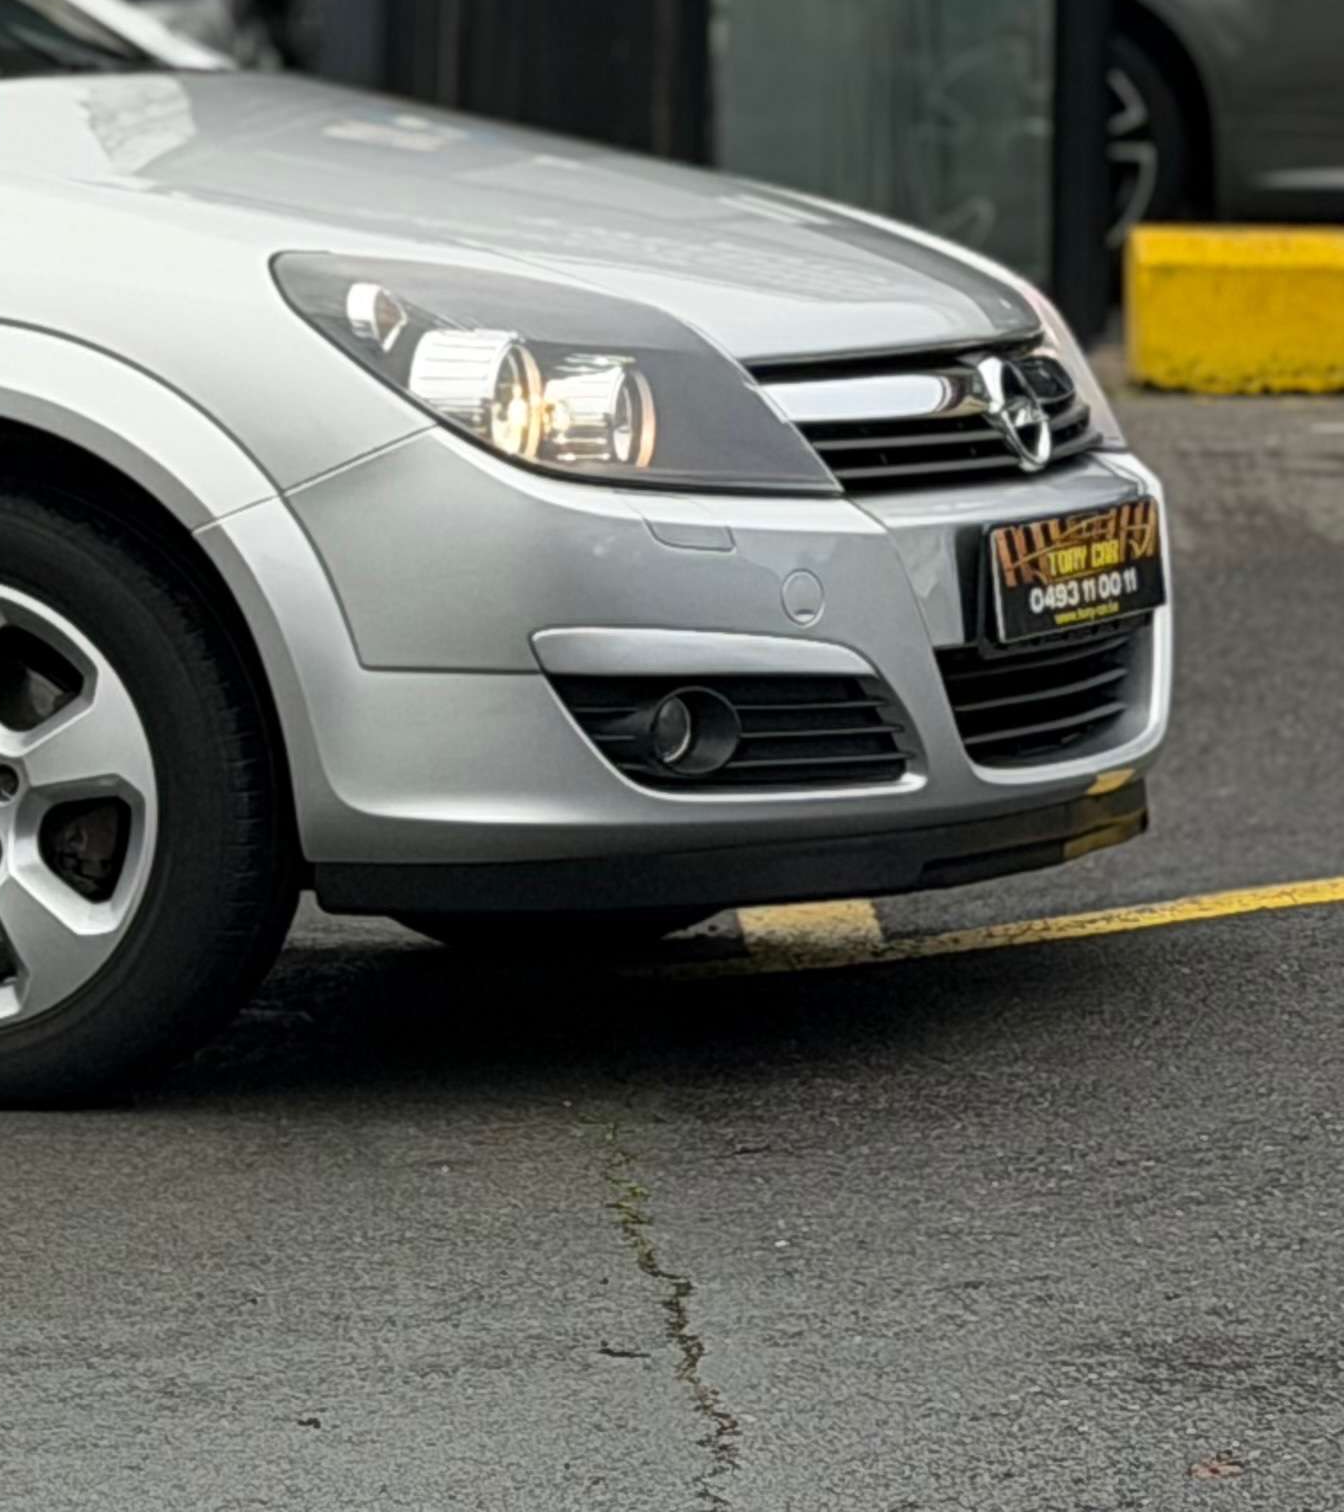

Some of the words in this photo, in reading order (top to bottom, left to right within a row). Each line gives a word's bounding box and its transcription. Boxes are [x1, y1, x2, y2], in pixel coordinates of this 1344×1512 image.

[1030, 582, 1080, 613] 0493
[1082, 579, 1095, 602] 11
[1098, 572, 1122, 599] 00
[1123, 568, 1137, 593] 11
